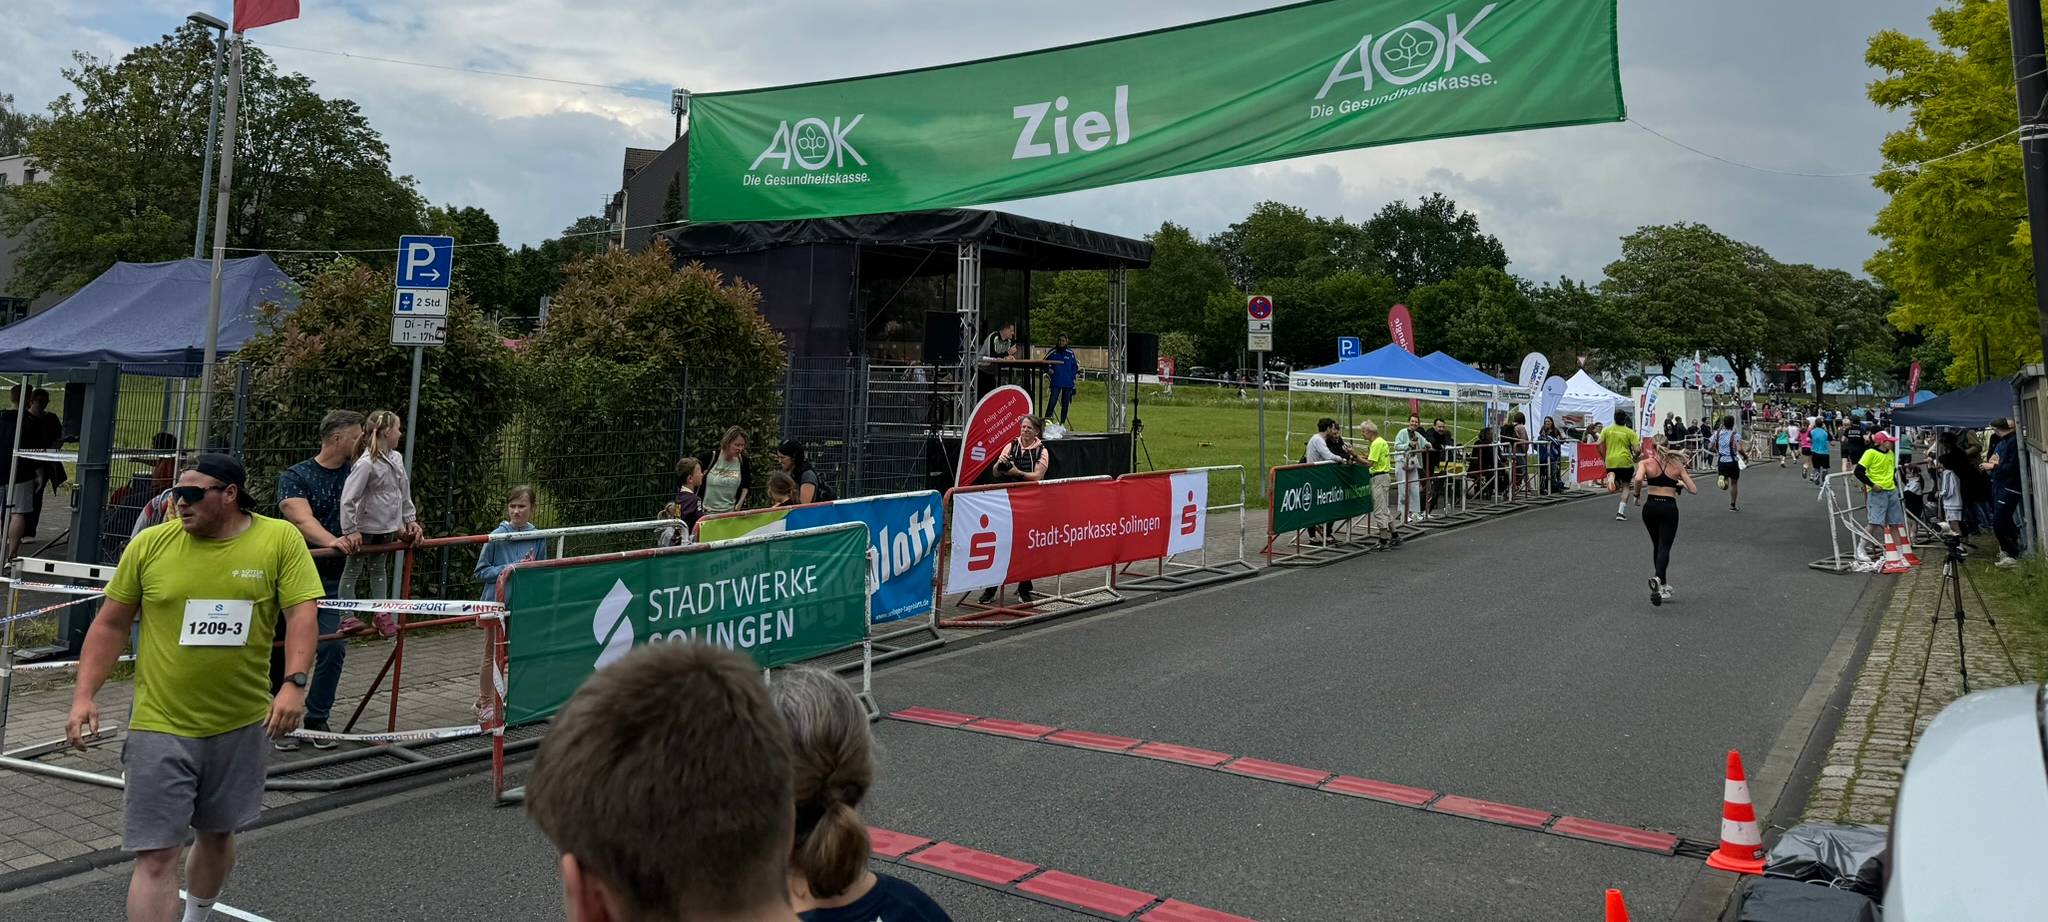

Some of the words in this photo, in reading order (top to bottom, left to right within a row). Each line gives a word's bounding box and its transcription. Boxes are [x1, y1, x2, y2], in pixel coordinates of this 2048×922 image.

[1314, 2, 1499, 100] AOK
[1310, 105, 1334, 119] Die
[1338, 72, 1498, 114] Gesundheitskasse.
[1011, 84, 1130, 160] Ziel
[748, 113, 868, 171] AOK
[743, 174, 761, 186] Die
[764, 172, 871, 186] Gesundheitskasse.
[406, 243, 436, 281] P
[416, 298, 422, 307] 2
[424, 298, 442, 307] Std.
[404, 320, 414, 329] Di
[424, 321, 435, 329] Fr
[403, 332, 410, 341] 11
[420, 332, 434, 341] 17h
[1342, 340, 1353, 355] P
[1310, 378, 1340, 389] Solinger
[1343, 380, 1377, 390] Tageblatt
[1280, 487, 1302, 513] AOK
[1317, 485, 1344, 505] Herzlich
[1028, 520, 1117, 549] Stadt-Sparkasse
[1119, 515, 1160, 536] Solingen
[648, 564, 817, 623] STADTWERKE
[381, 602, 448, 612] INTERSPORT
[188, 622, 243, 635] 1209-3
